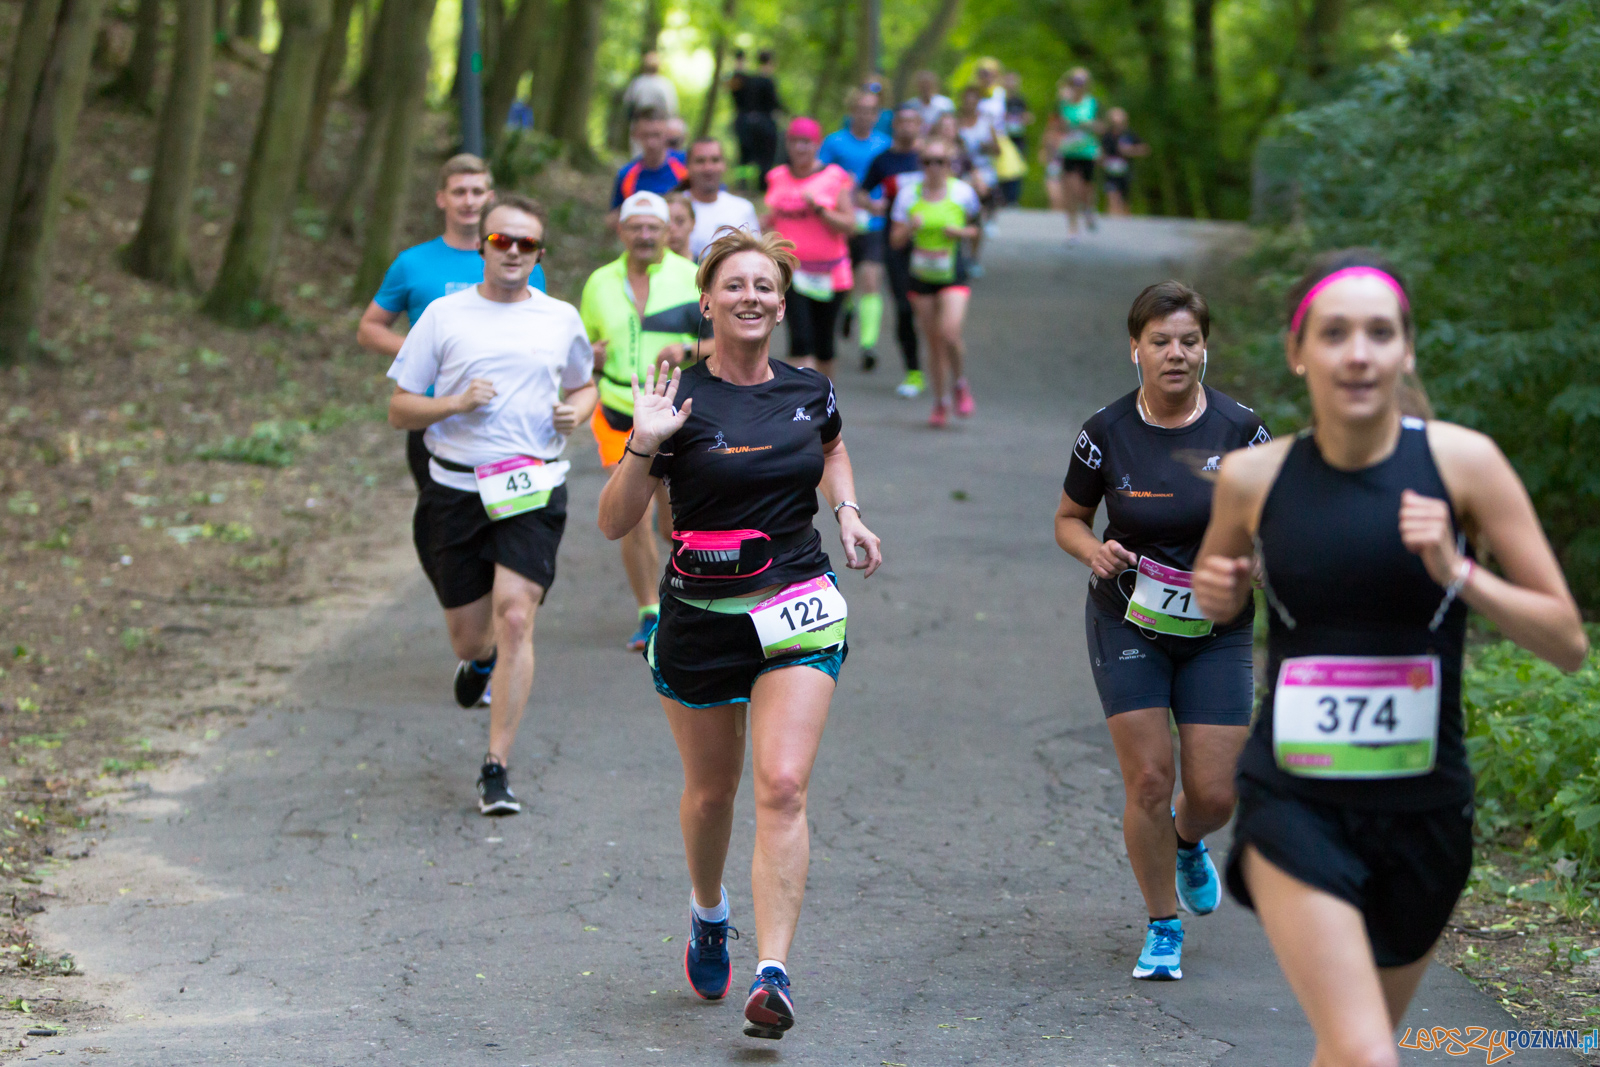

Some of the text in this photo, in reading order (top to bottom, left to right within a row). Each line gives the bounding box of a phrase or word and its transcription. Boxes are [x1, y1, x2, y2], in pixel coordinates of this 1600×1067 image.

[506, 472, 532, 492] 43
[780, 596, 829, 631] 122
[1161, 588, 1192, 613] 71
[1317, 694, 1399, 734] 374
